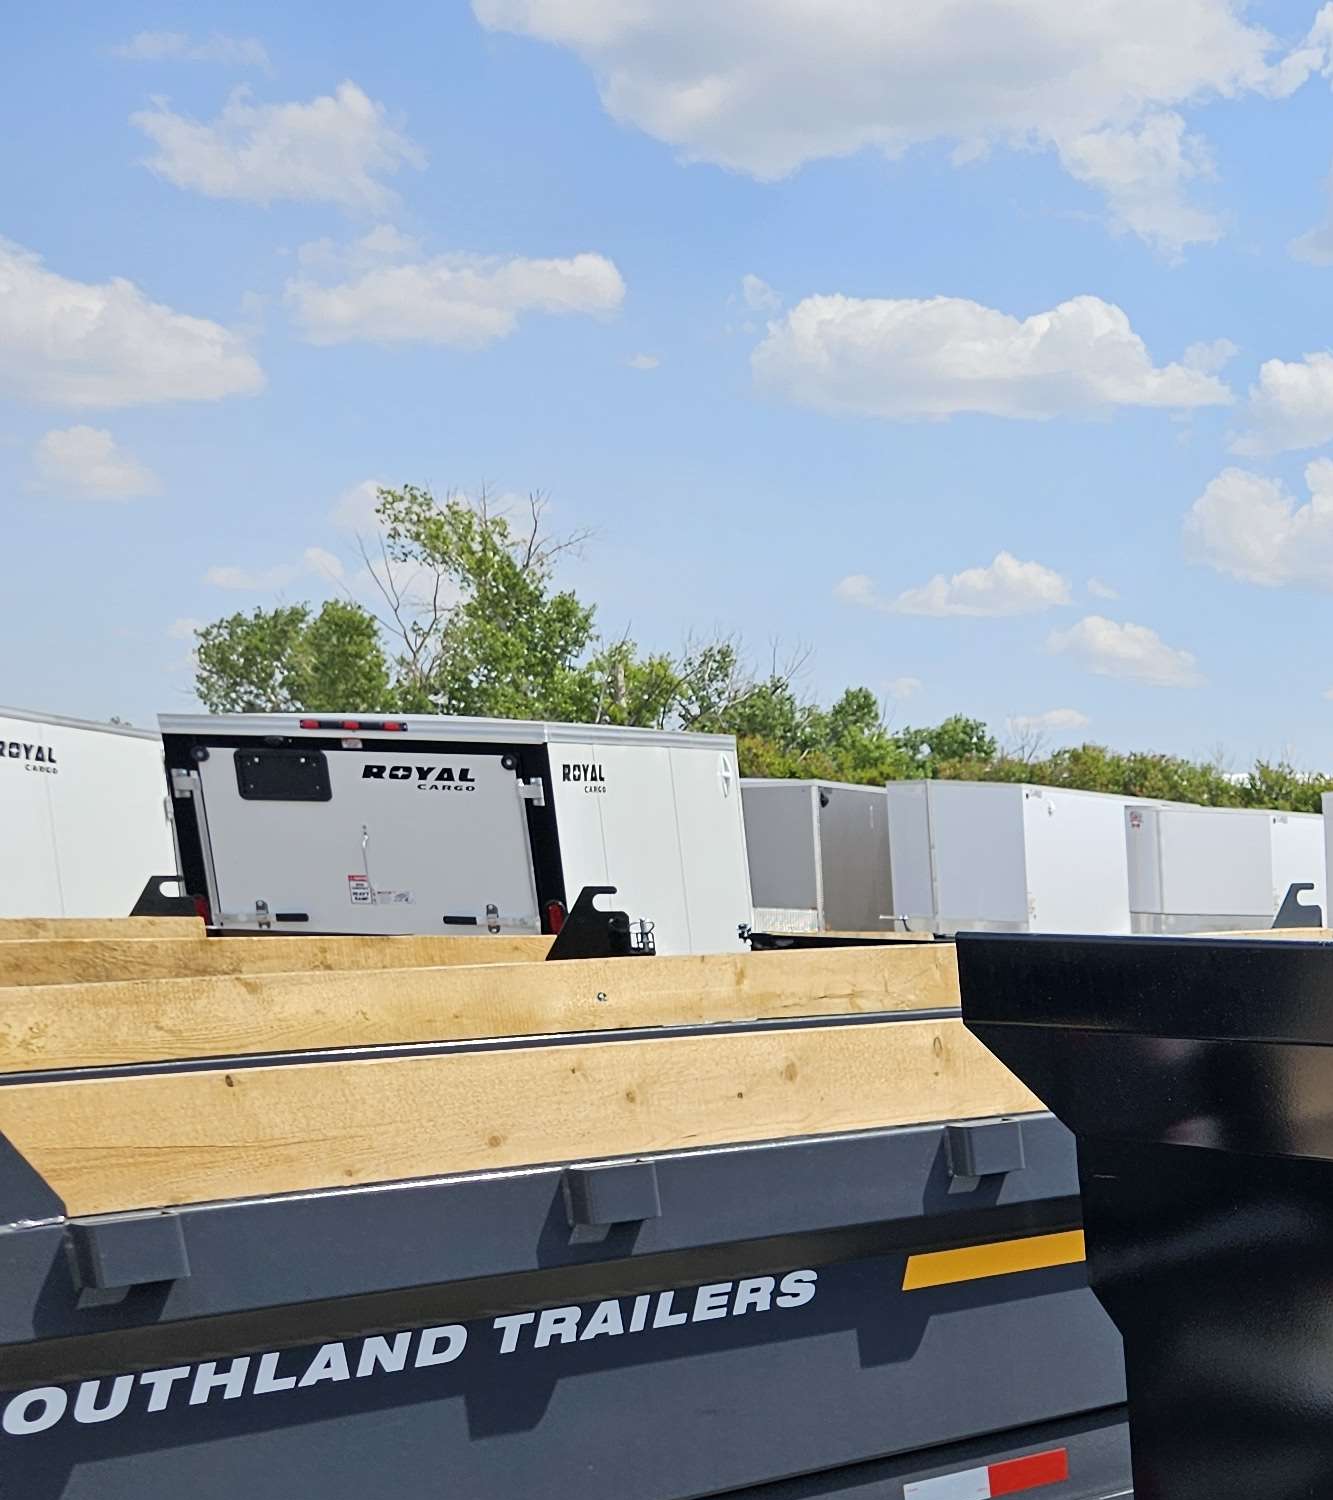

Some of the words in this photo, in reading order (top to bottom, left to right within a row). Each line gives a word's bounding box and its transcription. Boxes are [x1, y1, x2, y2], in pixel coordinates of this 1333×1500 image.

[361, 764, 476, 783] ROYAL
[562, 763, 605, 782] ROYAL
[417, 783, 476, 792] CARGO
[584, 786, 607, 794] CARGO
[493, 1268, 819, 1354] TRAILERS
